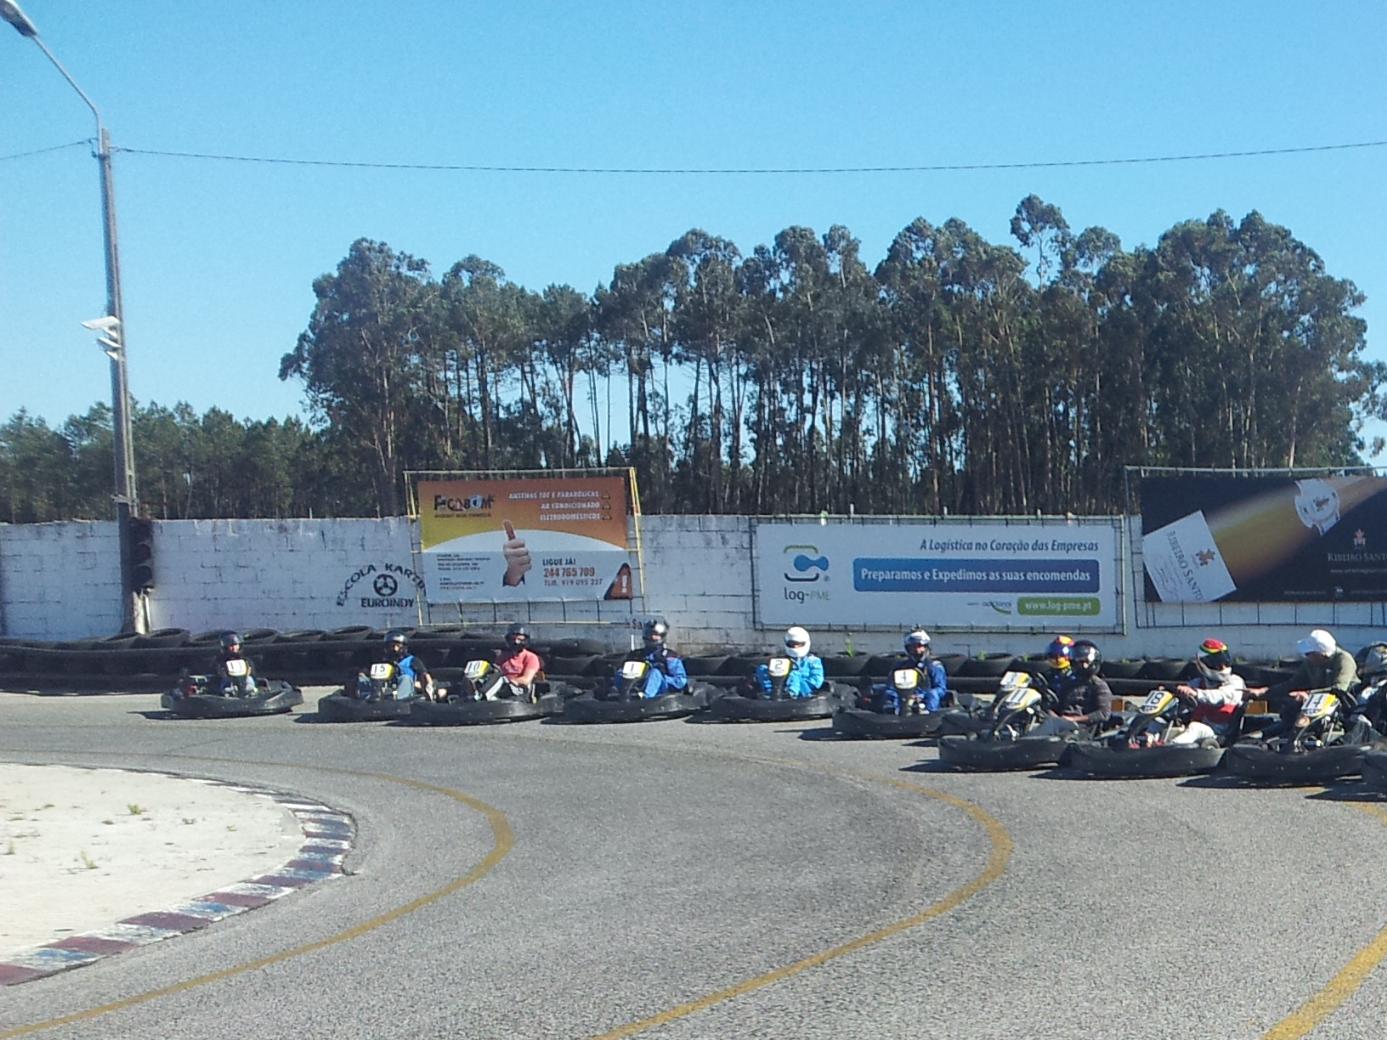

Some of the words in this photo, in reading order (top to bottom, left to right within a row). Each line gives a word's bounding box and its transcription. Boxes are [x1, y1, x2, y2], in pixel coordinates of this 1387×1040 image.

[920, 539, 927, 550] A
[929, 538, 973, 553] Logística
[974, 541, 988, 551] no
[990, 539, 1030, 553] Coração
[1031, 539, 1049, 551] das
[1051, 539, 1099, 553] Empresas
[861, 568, 922, 583] Preparamos
[924, 571, 930, 580] e
[932, 568, 987, 583] Expedimos
[989, 572, 1001, 581] as
[1002, 572, 1025, 581] suas
[1026, 569, 1091, 581] encomendas
[336, 564, 377, 607] ESCOLA
[361, 598, 414, 608] EUROINDY
[774, 659, 783, 670] 2
[1011, 688, 1028, 702] 11
[1145, 691, 1165, 705] 18
[1305, 694, 1324, 707] 14
